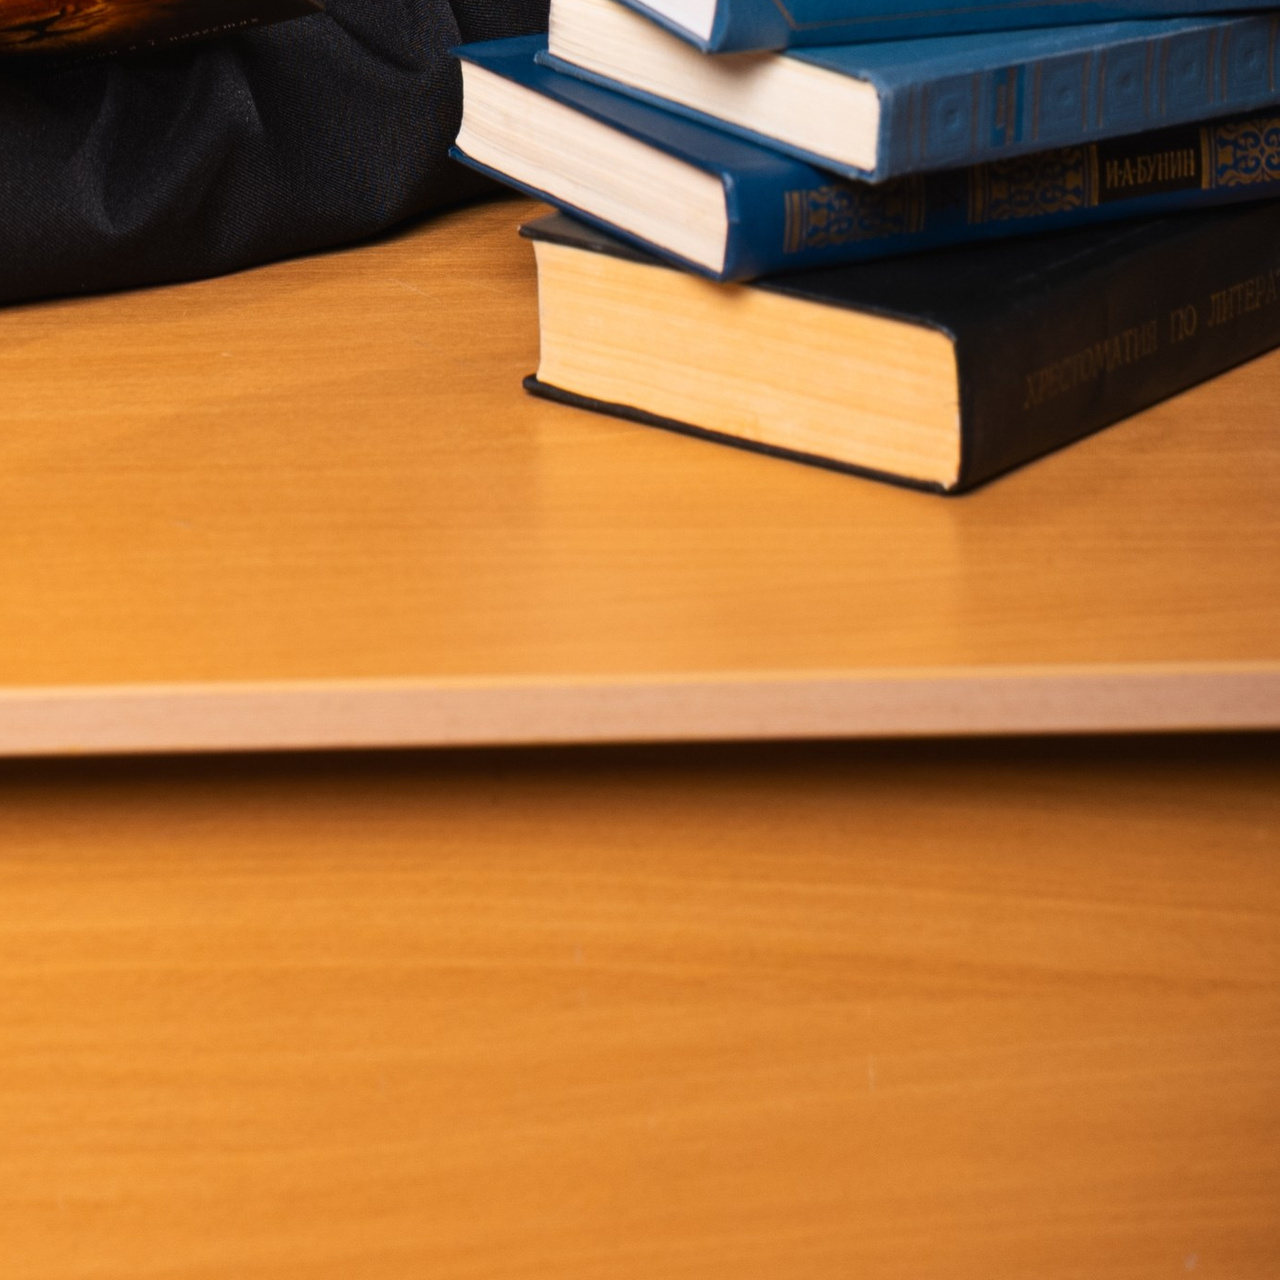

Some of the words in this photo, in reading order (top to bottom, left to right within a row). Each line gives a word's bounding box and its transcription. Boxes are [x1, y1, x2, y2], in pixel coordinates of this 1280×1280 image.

[1023, 318, 1158, 411] ХРЕСТОМАТИЯ
[1169, 303, 1198, 345] ПО
[1207, 266, 1280, 328] ЛИТЕРА
